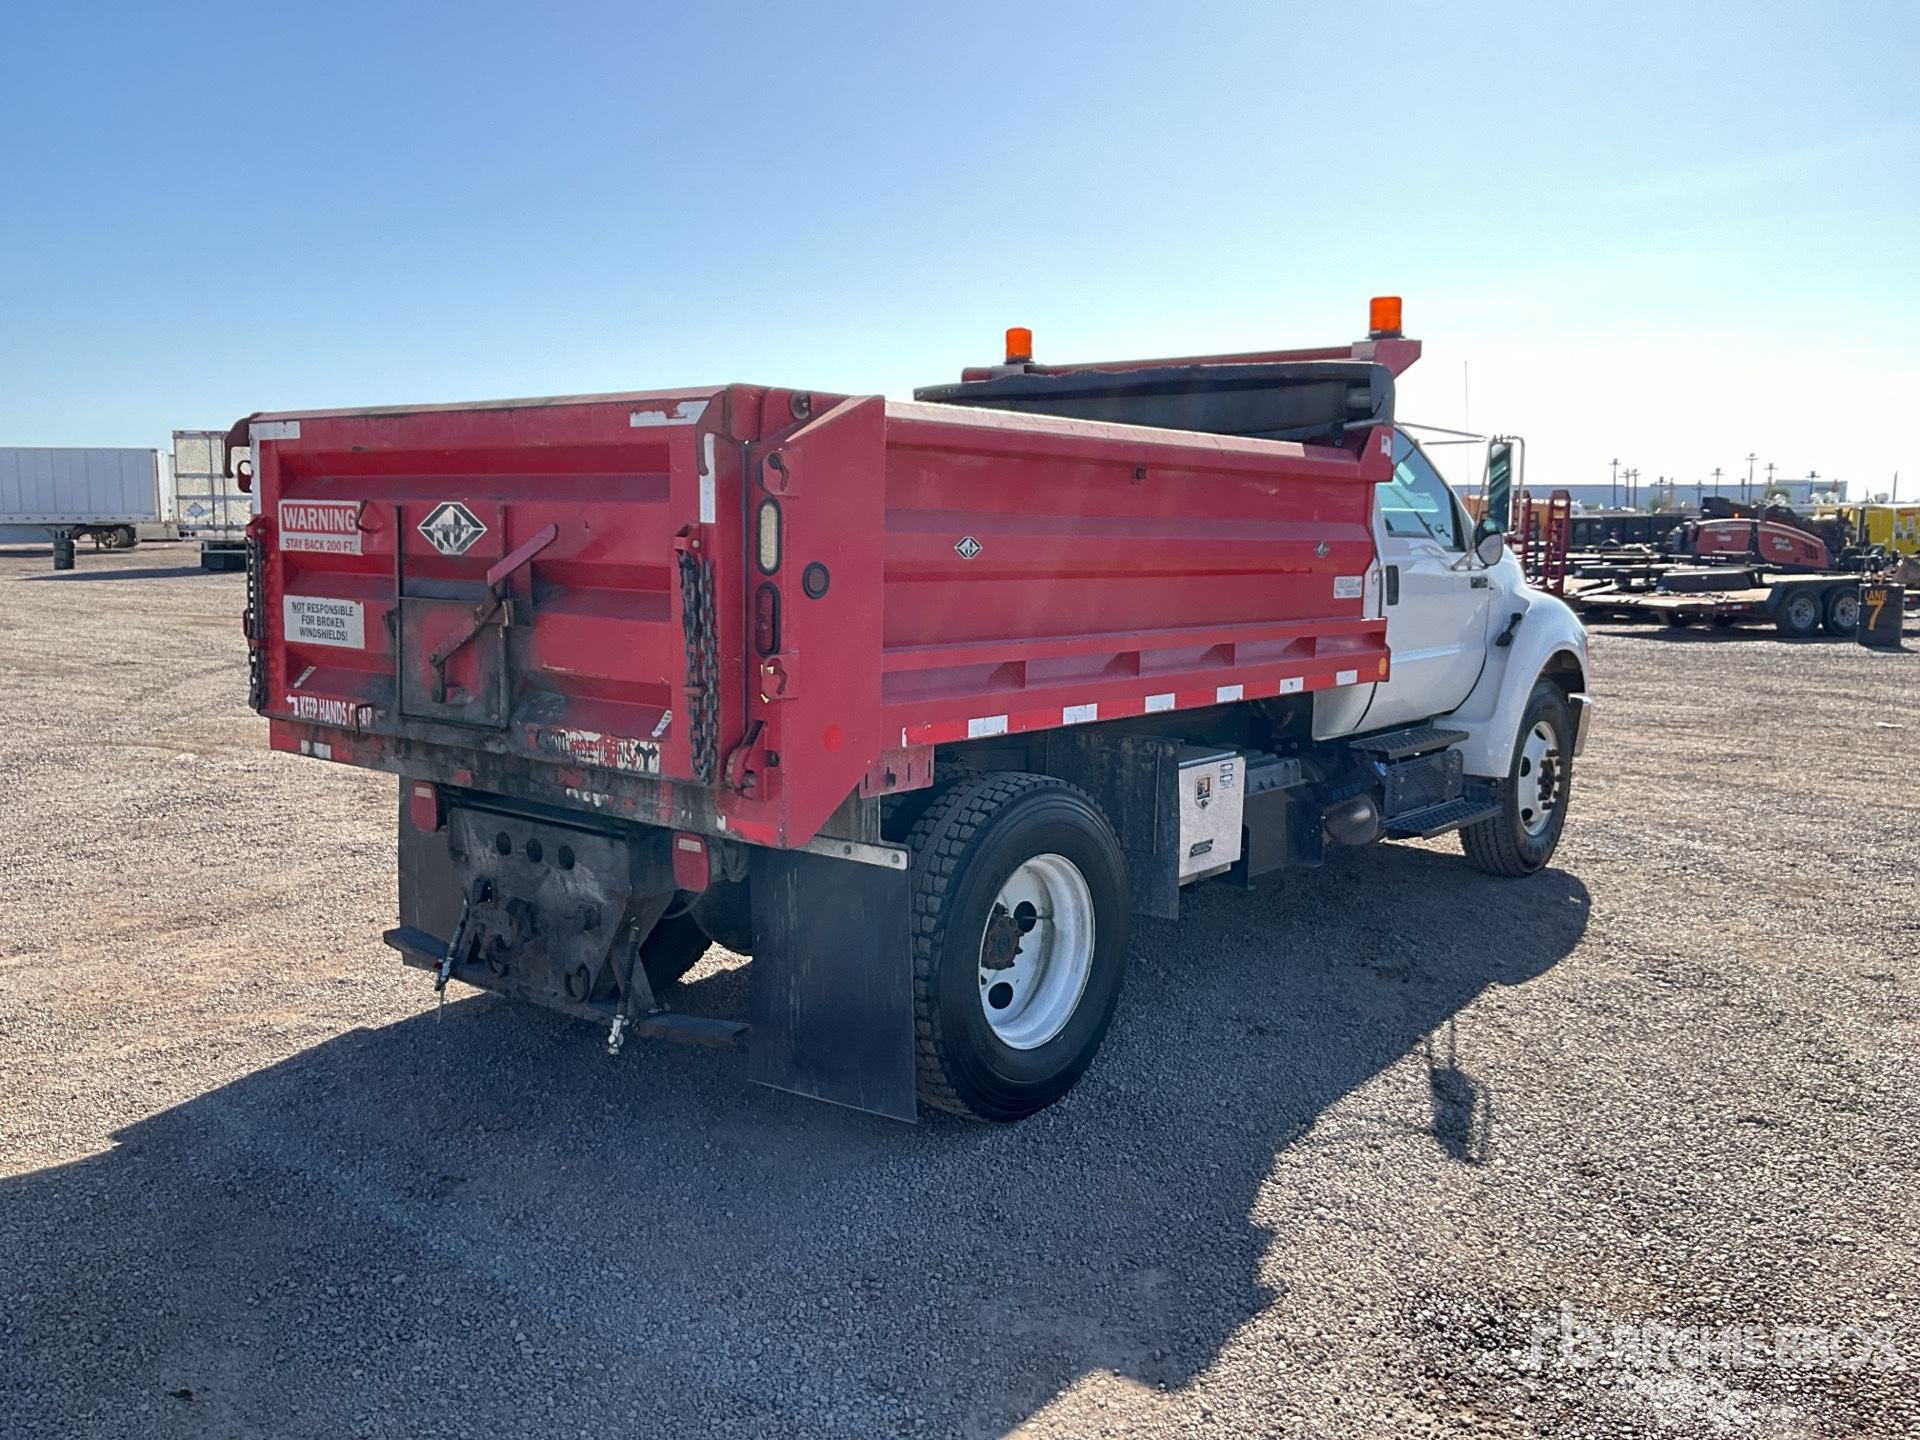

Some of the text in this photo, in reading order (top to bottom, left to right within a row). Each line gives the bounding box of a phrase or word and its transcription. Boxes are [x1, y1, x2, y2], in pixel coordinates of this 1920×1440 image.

[283, 507, 357, 531] WARNING
[286, 538, 355, 552] STAY BACK 200 FT.
[1864, 589, 1888, 601] LANE
[292, 602, 354, 616] NOT RESPONSIBLE
[1866, 600, 1885, 631] 7
[301, 614, 345, 628] FOR BROKEN
[299, 627, 348, 641] WINDSHIELDS!
[300, 695, 318, 719] KEEP
[319, 698, 347, 726] HANDS
